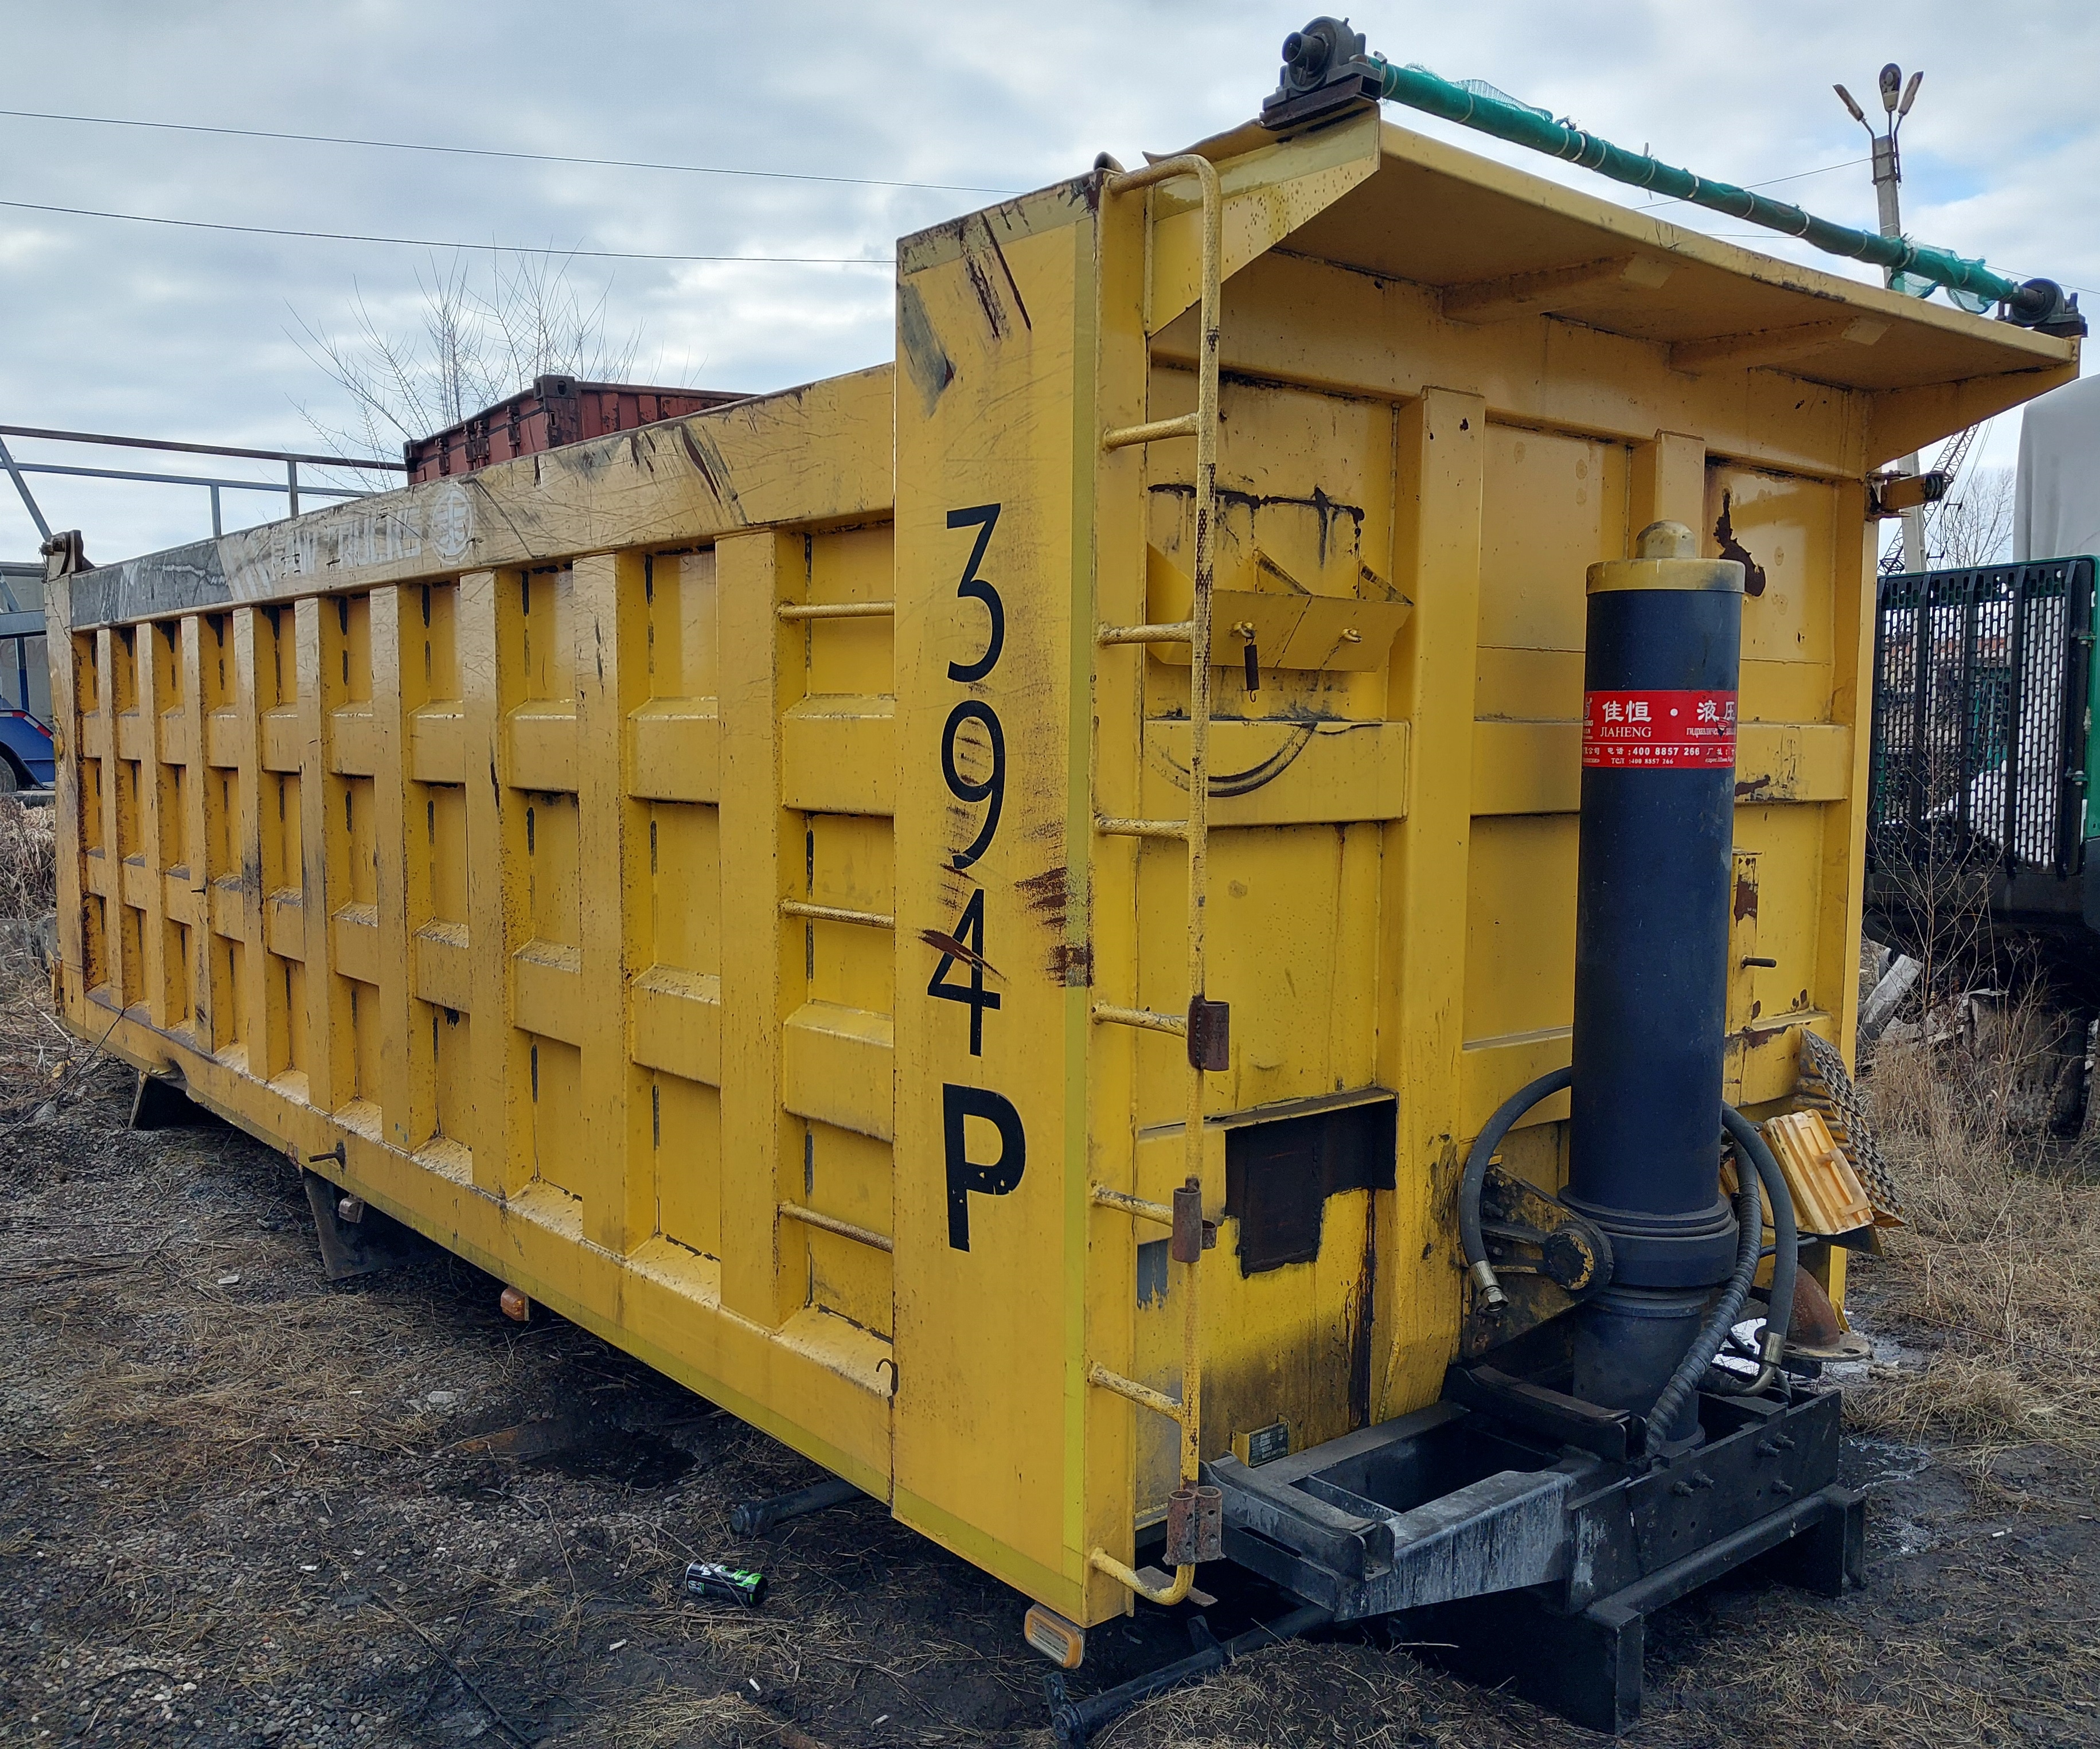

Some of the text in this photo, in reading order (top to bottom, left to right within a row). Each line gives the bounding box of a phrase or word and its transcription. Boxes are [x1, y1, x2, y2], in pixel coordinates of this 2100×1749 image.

[1602, 700, 1652, 723] 佳恒
[1600, 727, 1652, 737] JIAHENG
[1655, 747, 1679, 756] 8857
[1684, 747, 1700, 756] 266
